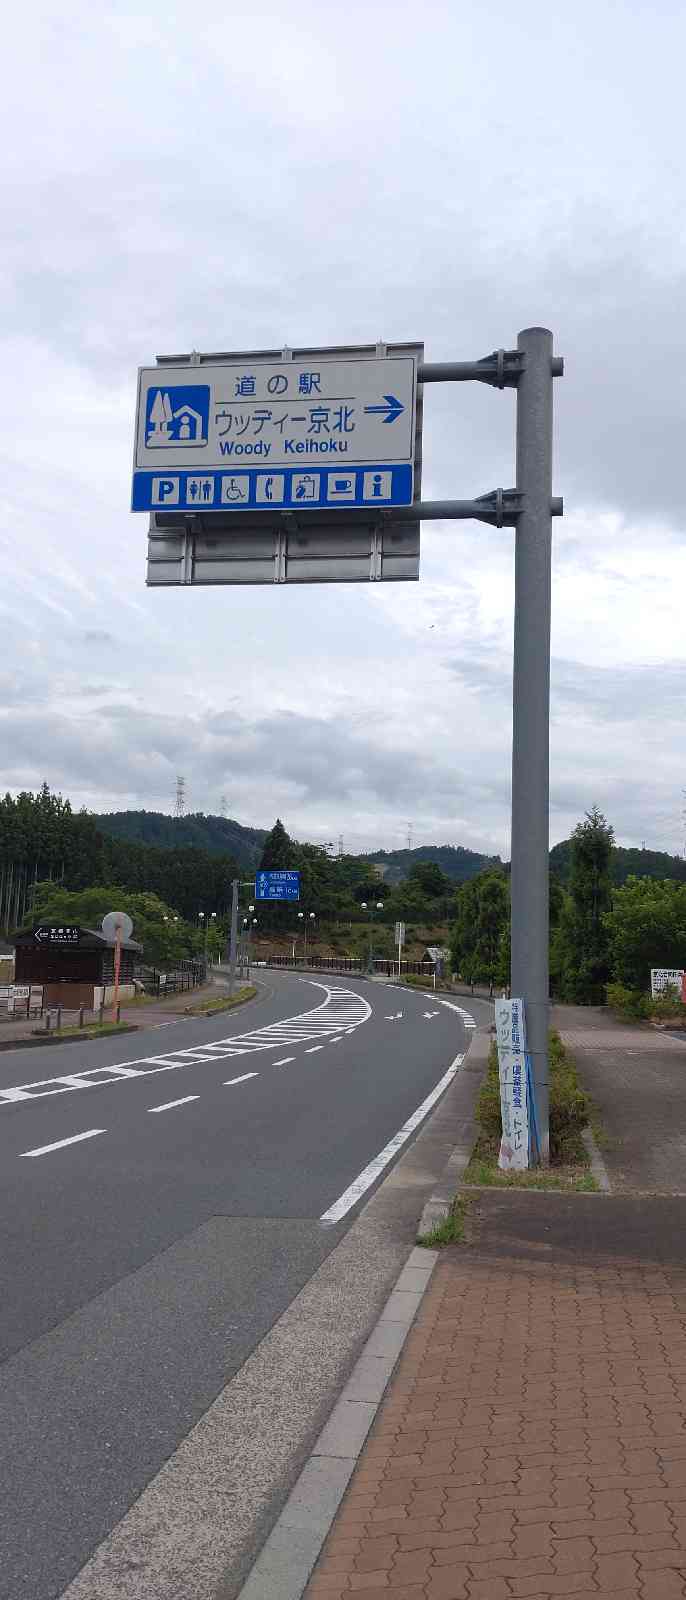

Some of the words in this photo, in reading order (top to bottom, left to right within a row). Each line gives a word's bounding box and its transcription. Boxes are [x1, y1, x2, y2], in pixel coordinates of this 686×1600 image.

[234, 373, 321, 397] 道の駅
[215, 405, 355, 436] ウッディー京北
[219, 440, 271, 457] Woody
[284, 438, 348, 454] Keihoku
